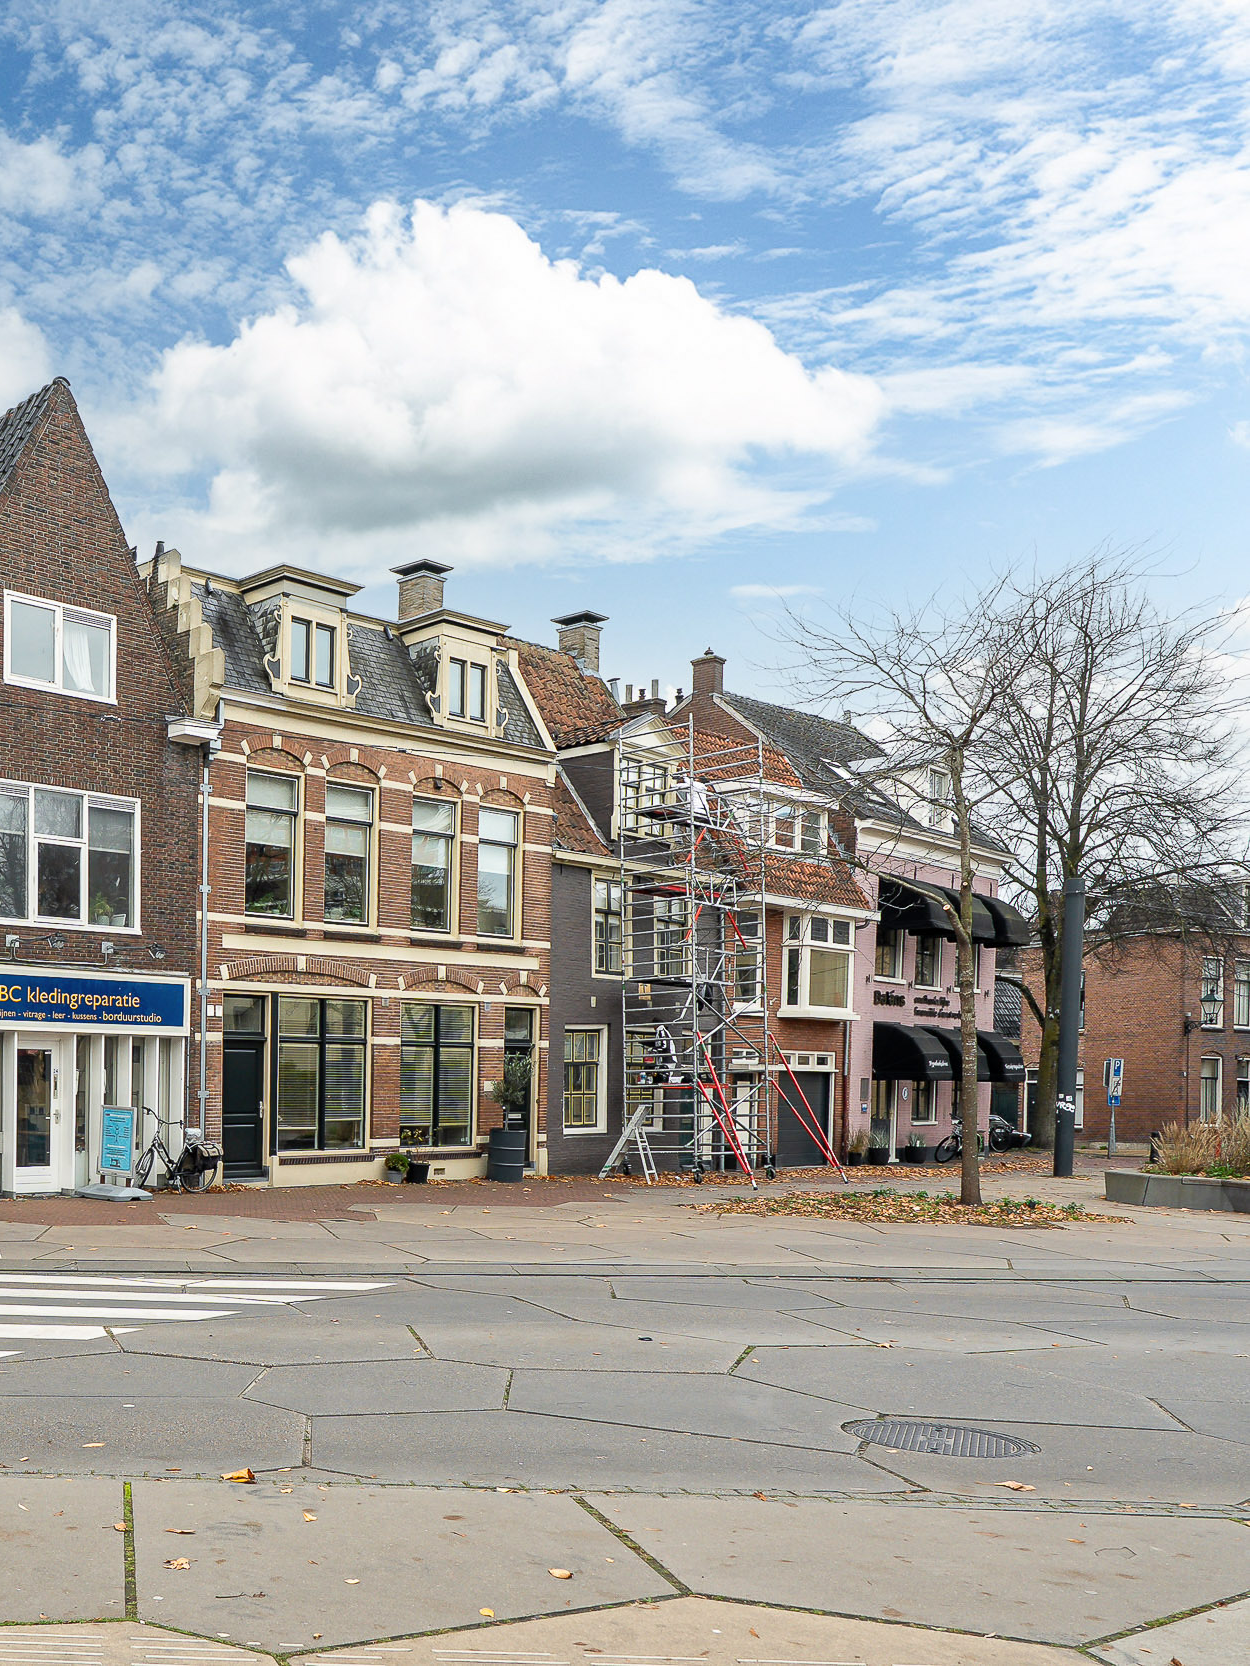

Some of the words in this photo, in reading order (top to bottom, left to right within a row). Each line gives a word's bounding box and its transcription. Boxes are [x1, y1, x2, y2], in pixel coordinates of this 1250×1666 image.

[27, 987, 141, 1009] kledingreparatie
[22, 1010, 46, 1020] vitrage
[52, 1011, 66, 1019] leer
[72, 1012, 98, 1020] kussens
[102, 1012, 162, 1022] borduurstudio
[1115, 1061, 1120, 1070] P
